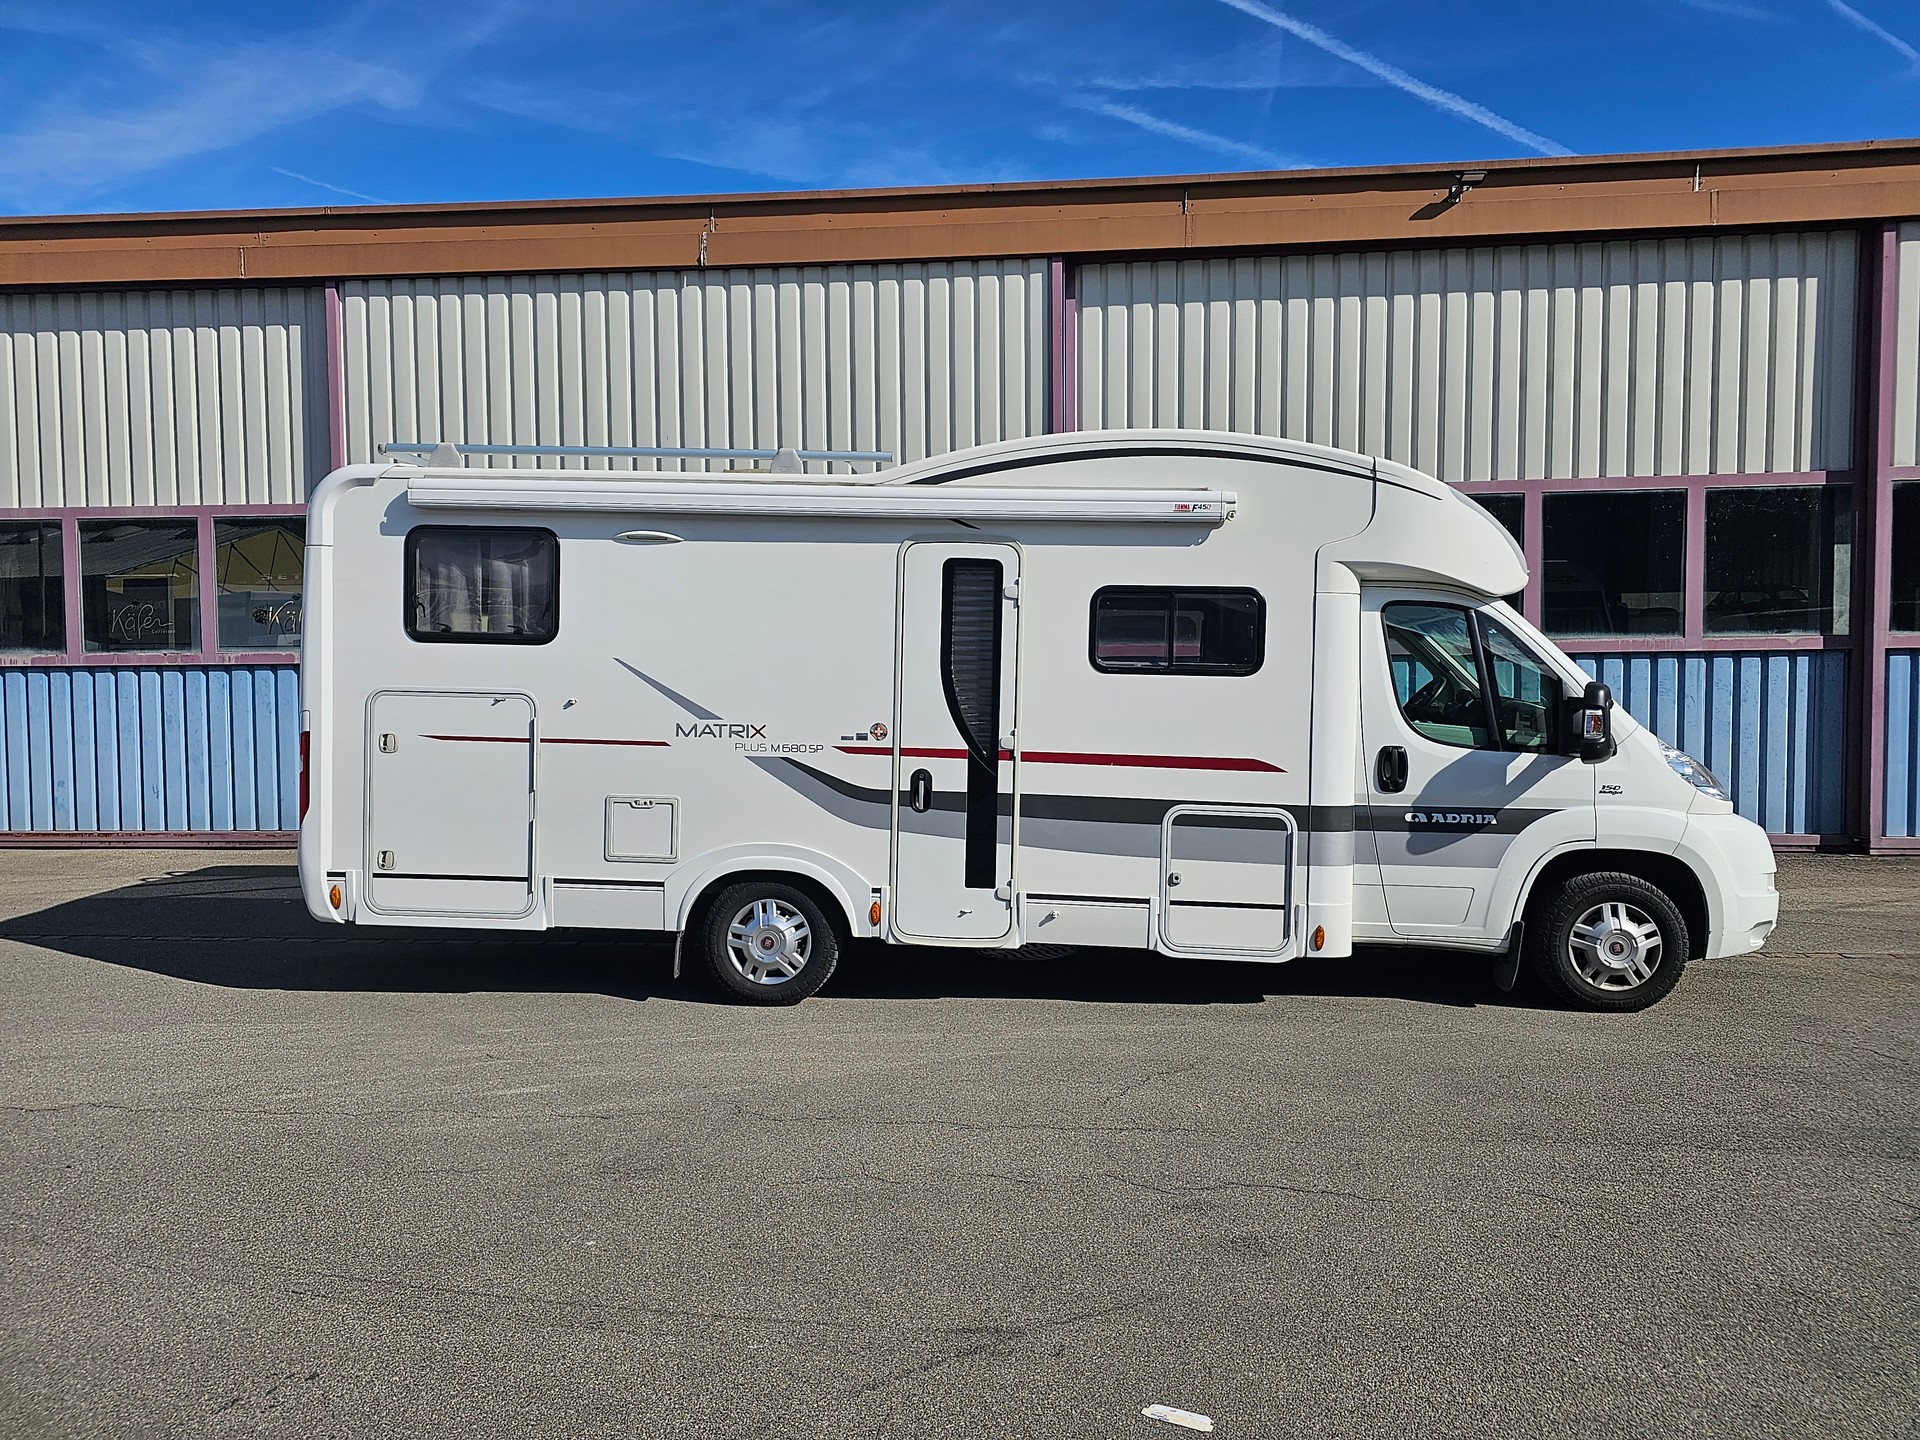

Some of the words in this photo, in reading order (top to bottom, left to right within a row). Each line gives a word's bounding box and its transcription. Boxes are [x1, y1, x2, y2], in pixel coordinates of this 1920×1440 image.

[675, 722, 767, 739] MATRIX
[734, 742, 768, 752] PLUS
[1431, 813, 1498, 825] ADRIA
